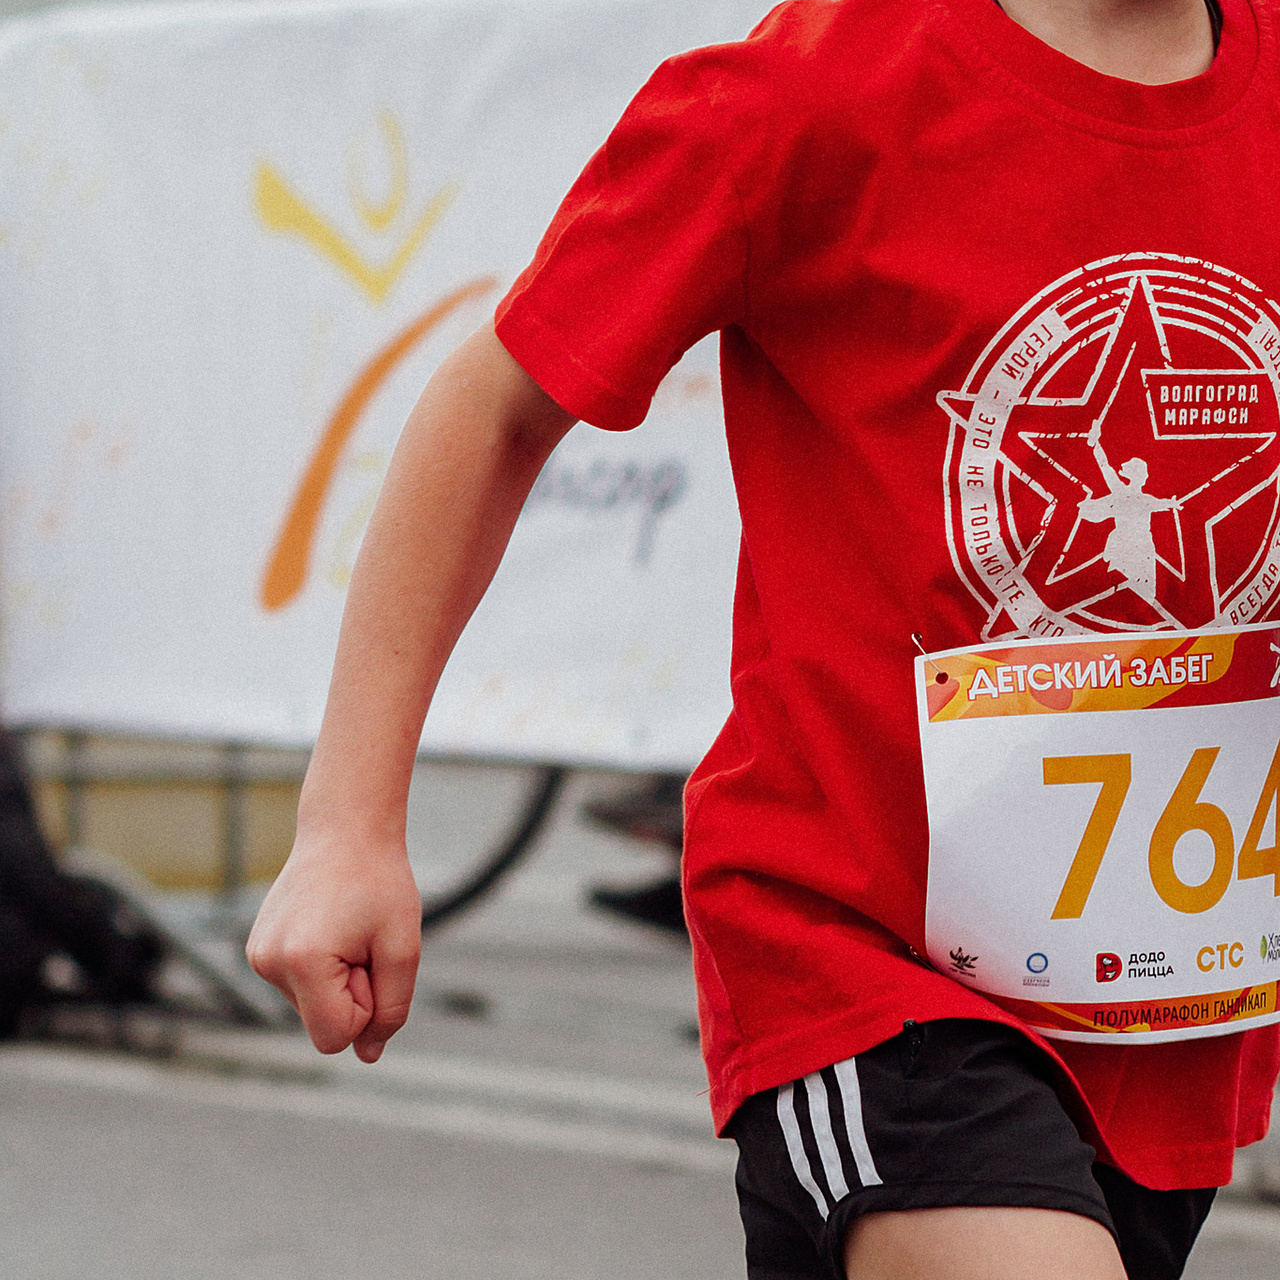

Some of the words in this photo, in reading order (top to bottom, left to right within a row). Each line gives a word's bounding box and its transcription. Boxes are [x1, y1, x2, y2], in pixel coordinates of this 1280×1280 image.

[1001, 323, 1054, 381] ГЕРОЙ
[1160, 384, 1259, 403] ВОЛГОГРАД
[972, 412, 997, 450] ЭТО
[966, 465, 985, 488] НЕ
[970, 503, 1005, 576] ТОЛЬКО
[1229, 562, 1280, 626] ВСЕГДА
[967, 653, 1122, 700] ДЕТСКИЙ
[1130, 653, 1213, 687] ЗАБЕГ
[1128, 951, 1166, 966] ДОДО
[1128, 965, 1175, 979] ПИЦЦА
[1196, 941, 1244, 972] СТС
[1094, 1002, 1209, 1026] ПОЛУМАРАФОН
[1213, 991, 1267, 1018] ГАНДИКАП
